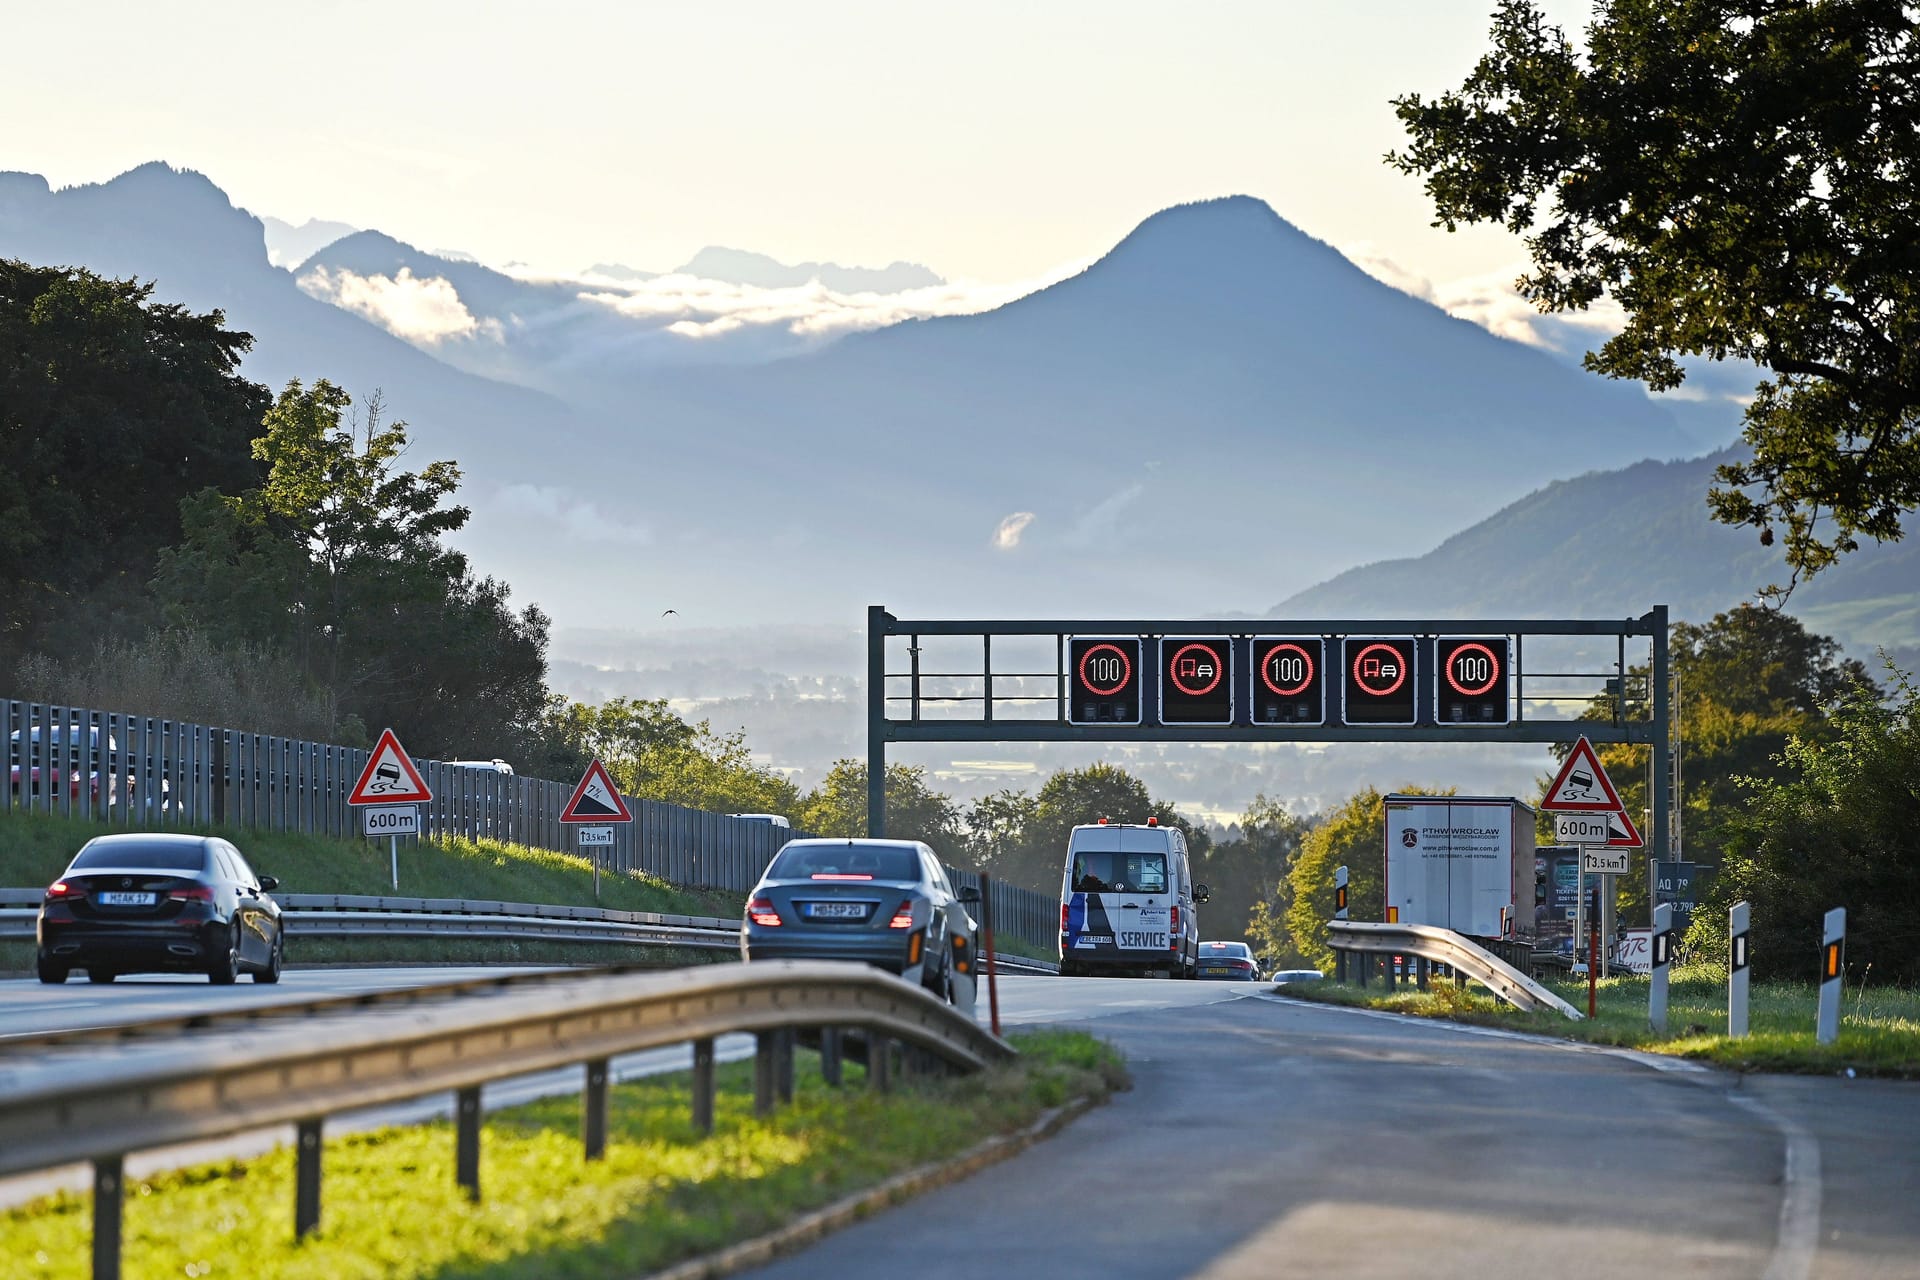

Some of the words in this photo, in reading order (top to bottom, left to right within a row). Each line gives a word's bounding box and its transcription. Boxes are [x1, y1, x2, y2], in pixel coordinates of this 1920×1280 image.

[1089, 657, 1120, 682] 100
[1272, 657, 1302, 682] 100
[1456, 657, 1488, 682] 100
[1422, 827, 1449, 835] PTHW
[1658, 878, 1671, 890] AQ
[1120, 931, 1166, 948] SERVICE
